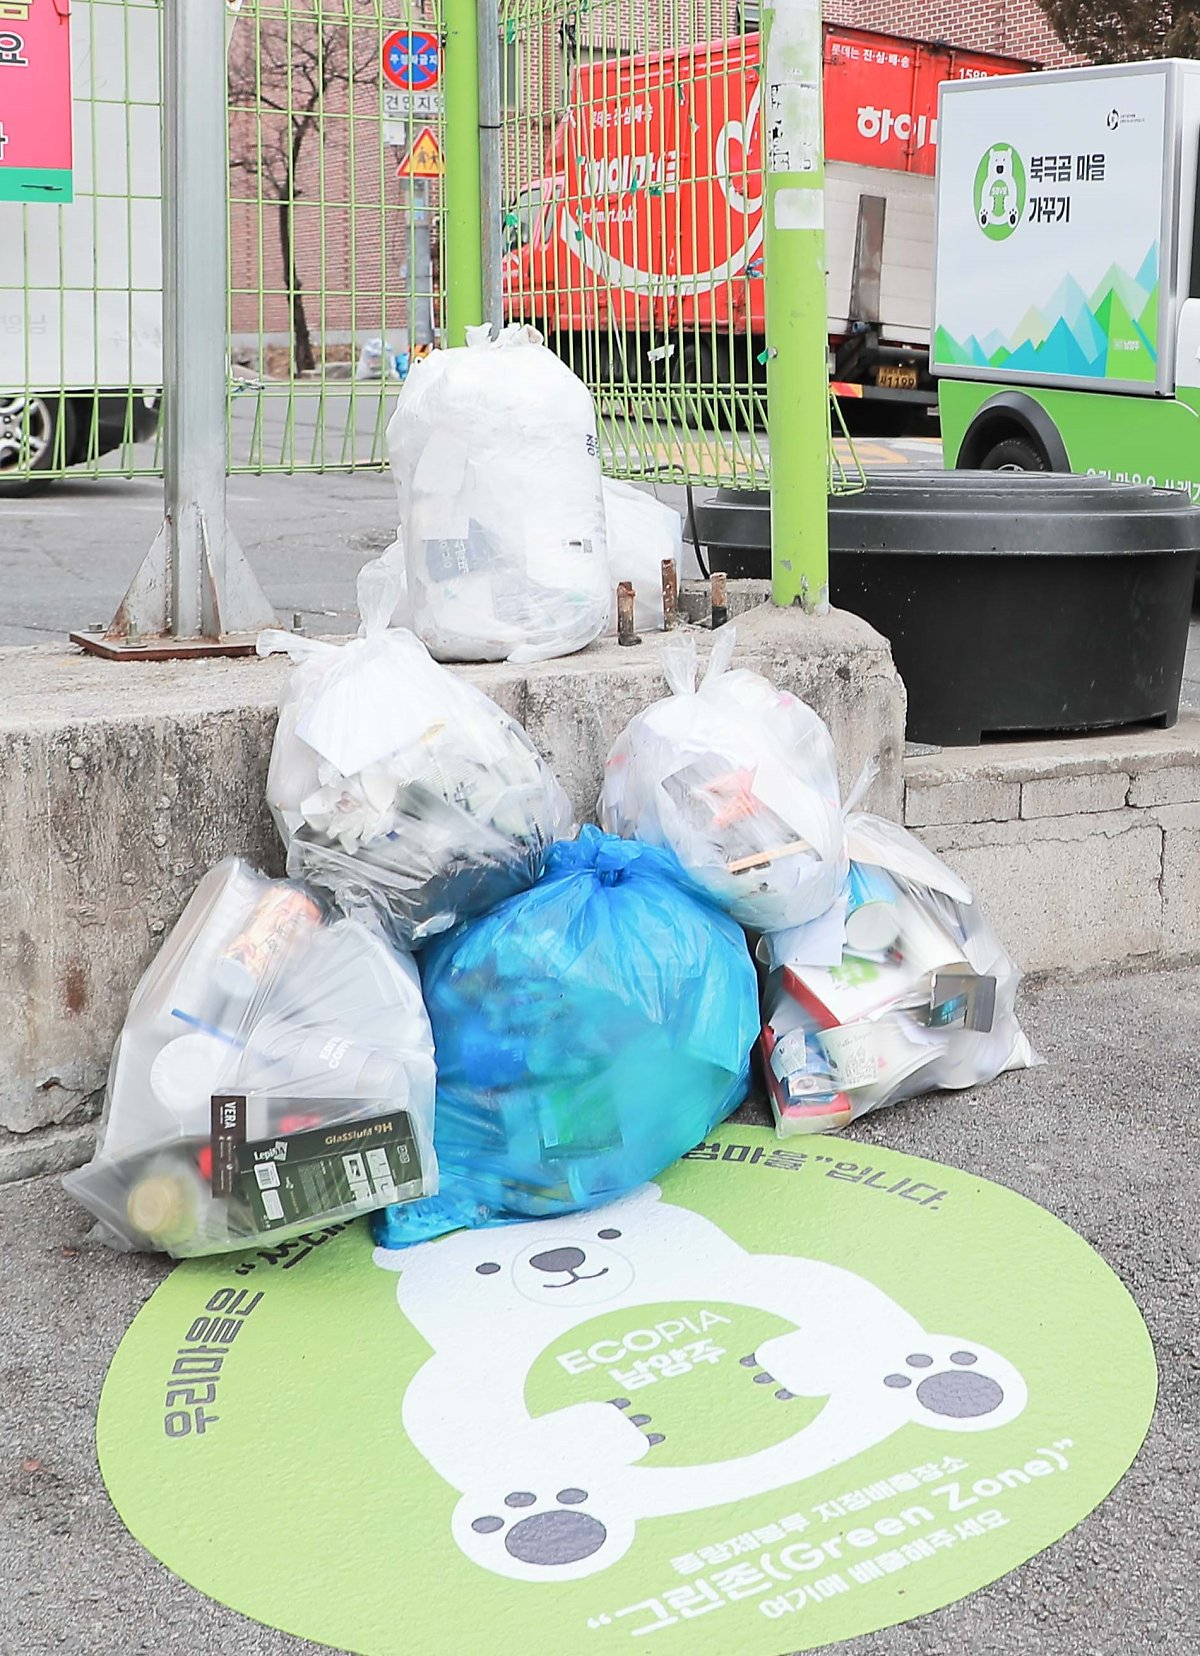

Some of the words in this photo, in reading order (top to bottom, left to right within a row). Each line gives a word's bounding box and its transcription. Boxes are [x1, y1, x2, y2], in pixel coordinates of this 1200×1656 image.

[831, 43, 859, 61] 롯데는
[857, 105, 938, 150] 하이
[1030, 155, 1072, 183] 북극곰
[1076, 153, 1106, 182] 마을
[1028, 196, 1071, 223] 가꾸기
[224, 1101, 237, 1129] VERA
[164, 1287, 265, 1438] 우리마을은
[555, 1308, 732, 1375] ECOPIA
[608, 1337, 727, 1391] 남양주
[758, 1573, 850, 1619] 여기에
[847, 1509, 1010, 1584] 배출해주세요
